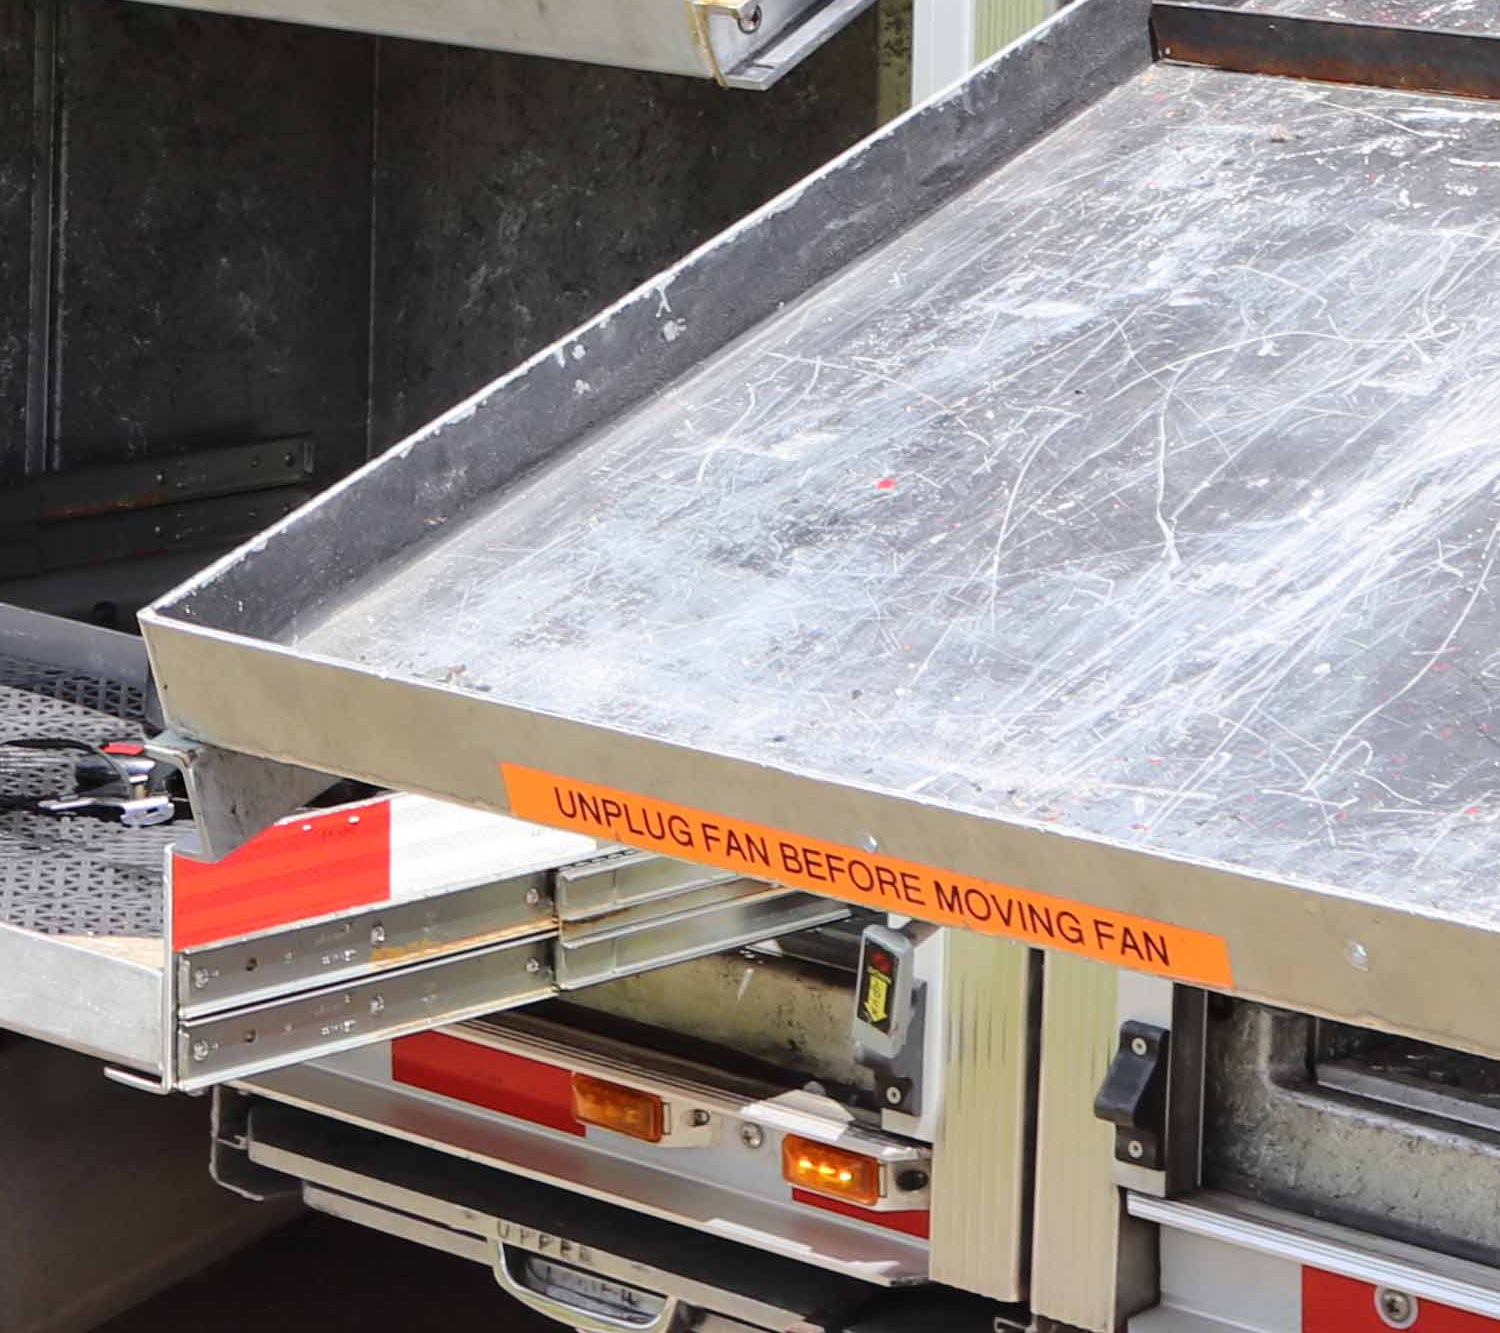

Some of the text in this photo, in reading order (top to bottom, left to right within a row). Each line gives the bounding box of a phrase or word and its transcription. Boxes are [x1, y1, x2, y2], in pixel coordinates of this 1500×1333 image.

[553, 786, 1171, 966] UNPLUG FAN BEFORE MOVING FAN
